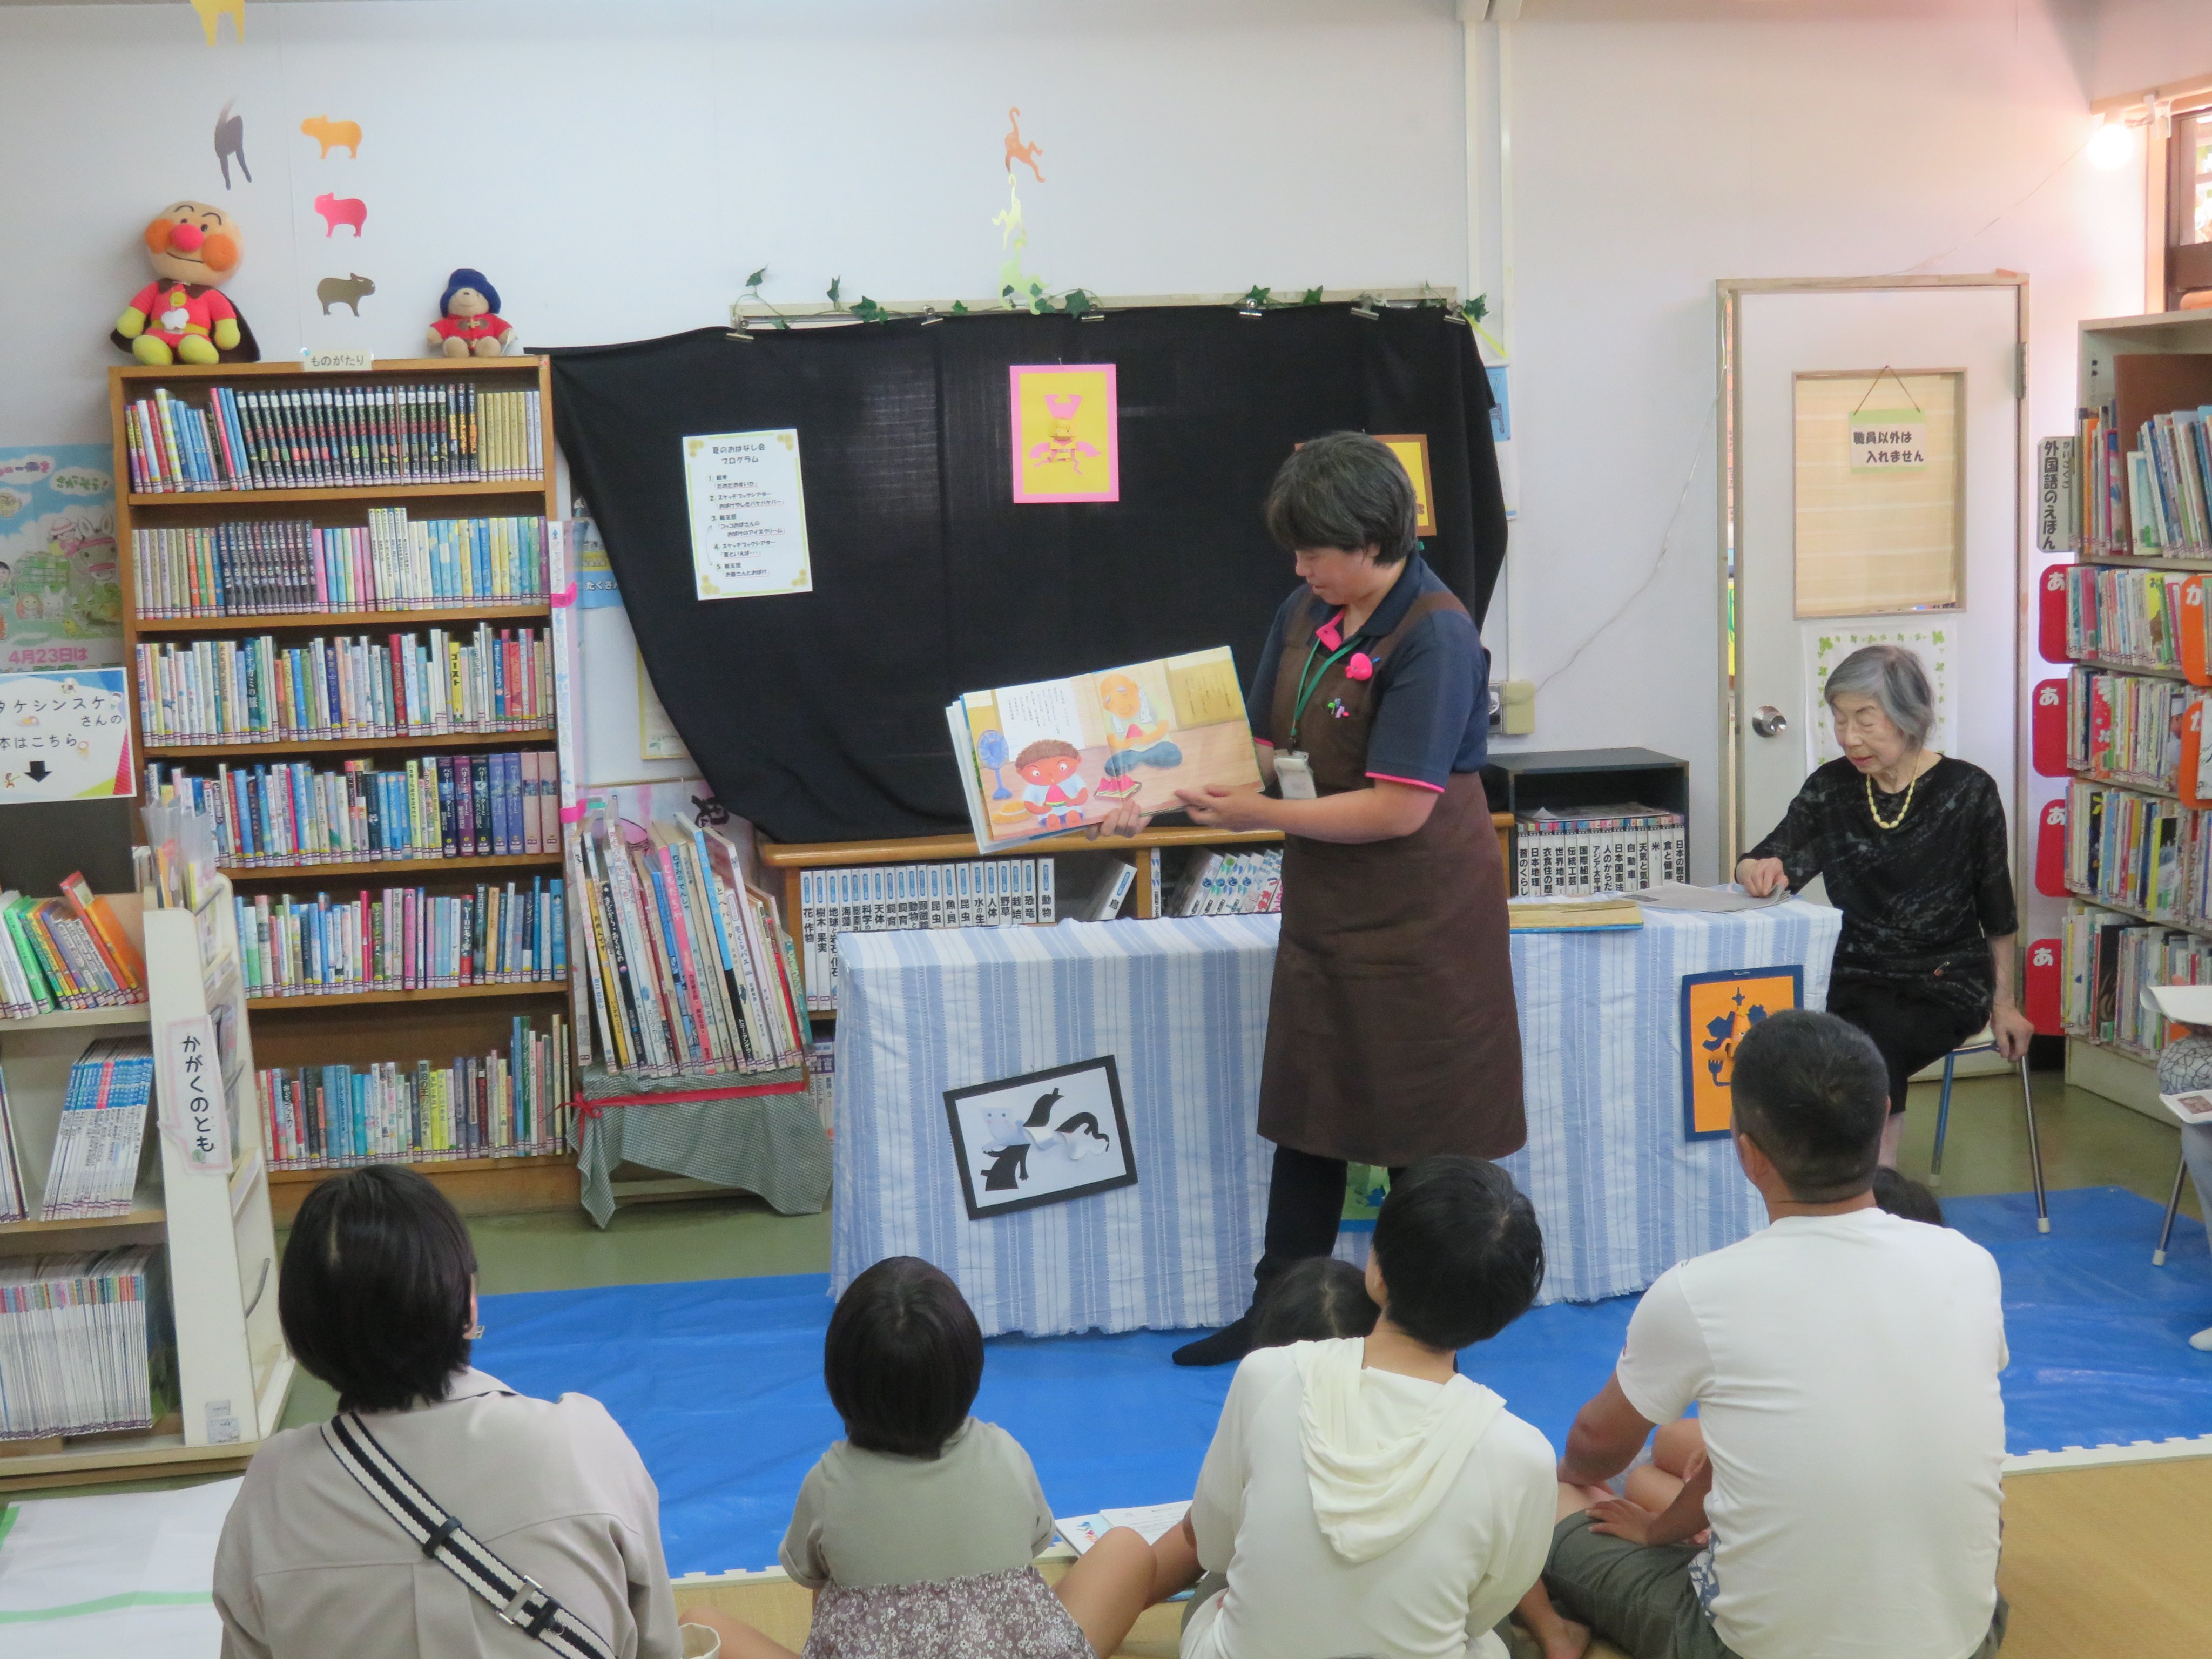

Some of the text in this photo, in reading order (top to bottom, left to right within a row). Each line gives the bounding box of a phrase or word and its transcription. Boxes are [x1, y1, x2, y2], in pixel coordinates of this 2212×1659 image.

[311, 355, 364, 366] ものがたり
[712, 443, 766, 454] 夏のおはなし会
[1853, 431, 1912, 444] 職員以外は
[721, 456, 759, 465] プログラム
[1866, 450, 1924, 463] 入れません
[2042, 440, 2059, 550] 外国語のえほん
[2047, 571, 2066, 591] あ
[8, 648, 89, 665] 4月23日は
[245, 645, 258, 709] オオカミの旅
[451, 652, 460, 686] ゴースト
[2039, 687, 2059, 706] あ
[82, 714, 122, 727] さんの
[0, 734, 77, 750] 本はこちら
[2047, 807, 2065, 825] あ
[1651, 842, 1660, 851] 米
[1519, 848, 1528, 896] 昔のくらし
[1531, 848, 1540, 887] 日本地理
[1543, 847, 1553, 895] 衣食住の歴
[1555, 847, 1564, 886] 世界地理
[1568, 847, 1576, 886] 伝統工芸
[1579, 846, 1589, 885] 国際組織
[1603, 845, 1612, 891] 人のからだ
[1615, 844, 1623, 891] 日本国憲法
[1627, 843, 1636, 879] 自動車
[1638, 842, 1648, 889] 天気と気象
[1663, 841, 1673, 880] 食と健康
[887, 903, 896, 926] 飼育
[898, 902, 907, 925] 飼育
[908, 901, 918, 928] 動物と
[946, 900, 956, 924] 魚・貝
[974, 898, 985, 926] 水の生
[988, 898, 997, 918] 人体
[1000, 896, 1010, 916] 野草
[1012, 896, 1022, 919] 栽培
[1024, 895, 1035, 918] 恐竜
[1042, 895, 1052, 918] 動物
[1108, 899, 1120, 910] 鳥
[803, 908, 814, 943] 花・作物
[874, 904, 885, 930] 天体・
[816, 908, 827, 953] 樹木・果実
[2033, 948, 2053, 966] あ
[183, 1035, 214, 1152] かがくのとも
